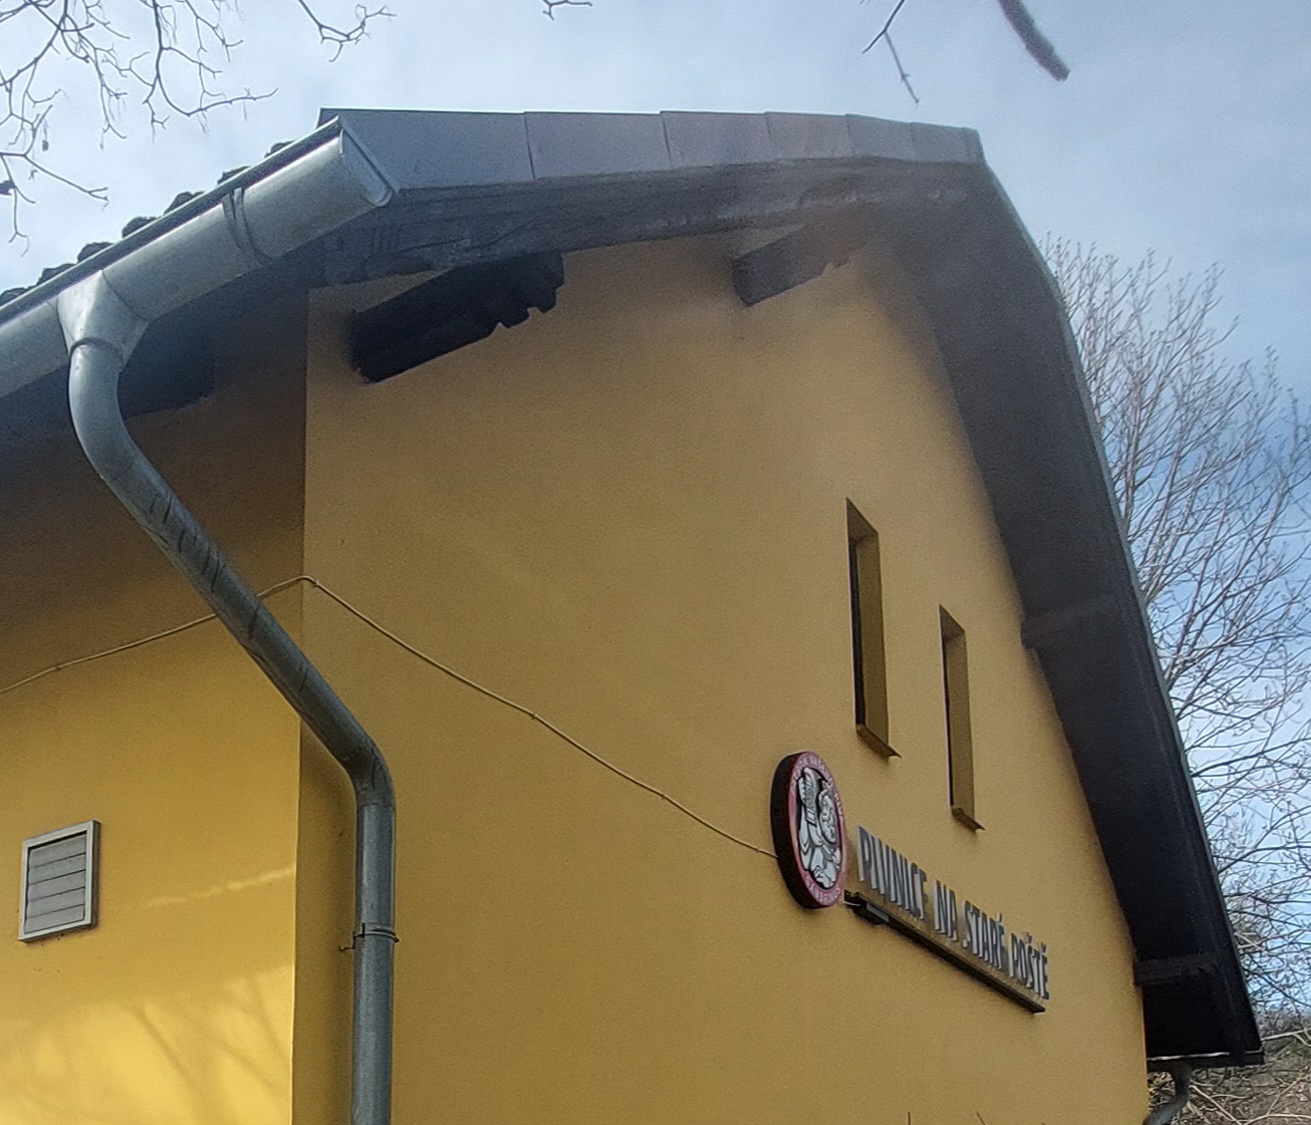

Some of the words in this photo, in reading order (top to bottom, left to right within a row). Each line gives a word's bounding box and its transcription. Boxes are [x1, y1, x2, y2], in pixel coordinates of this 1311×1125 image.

[856, 825, 928, 920] PIVNICE
[932, 877, 958, 943] NA
[961, 899, 1007, 973] STARÉ
[1008, 931, 1050, 1000] POŠTĚ
